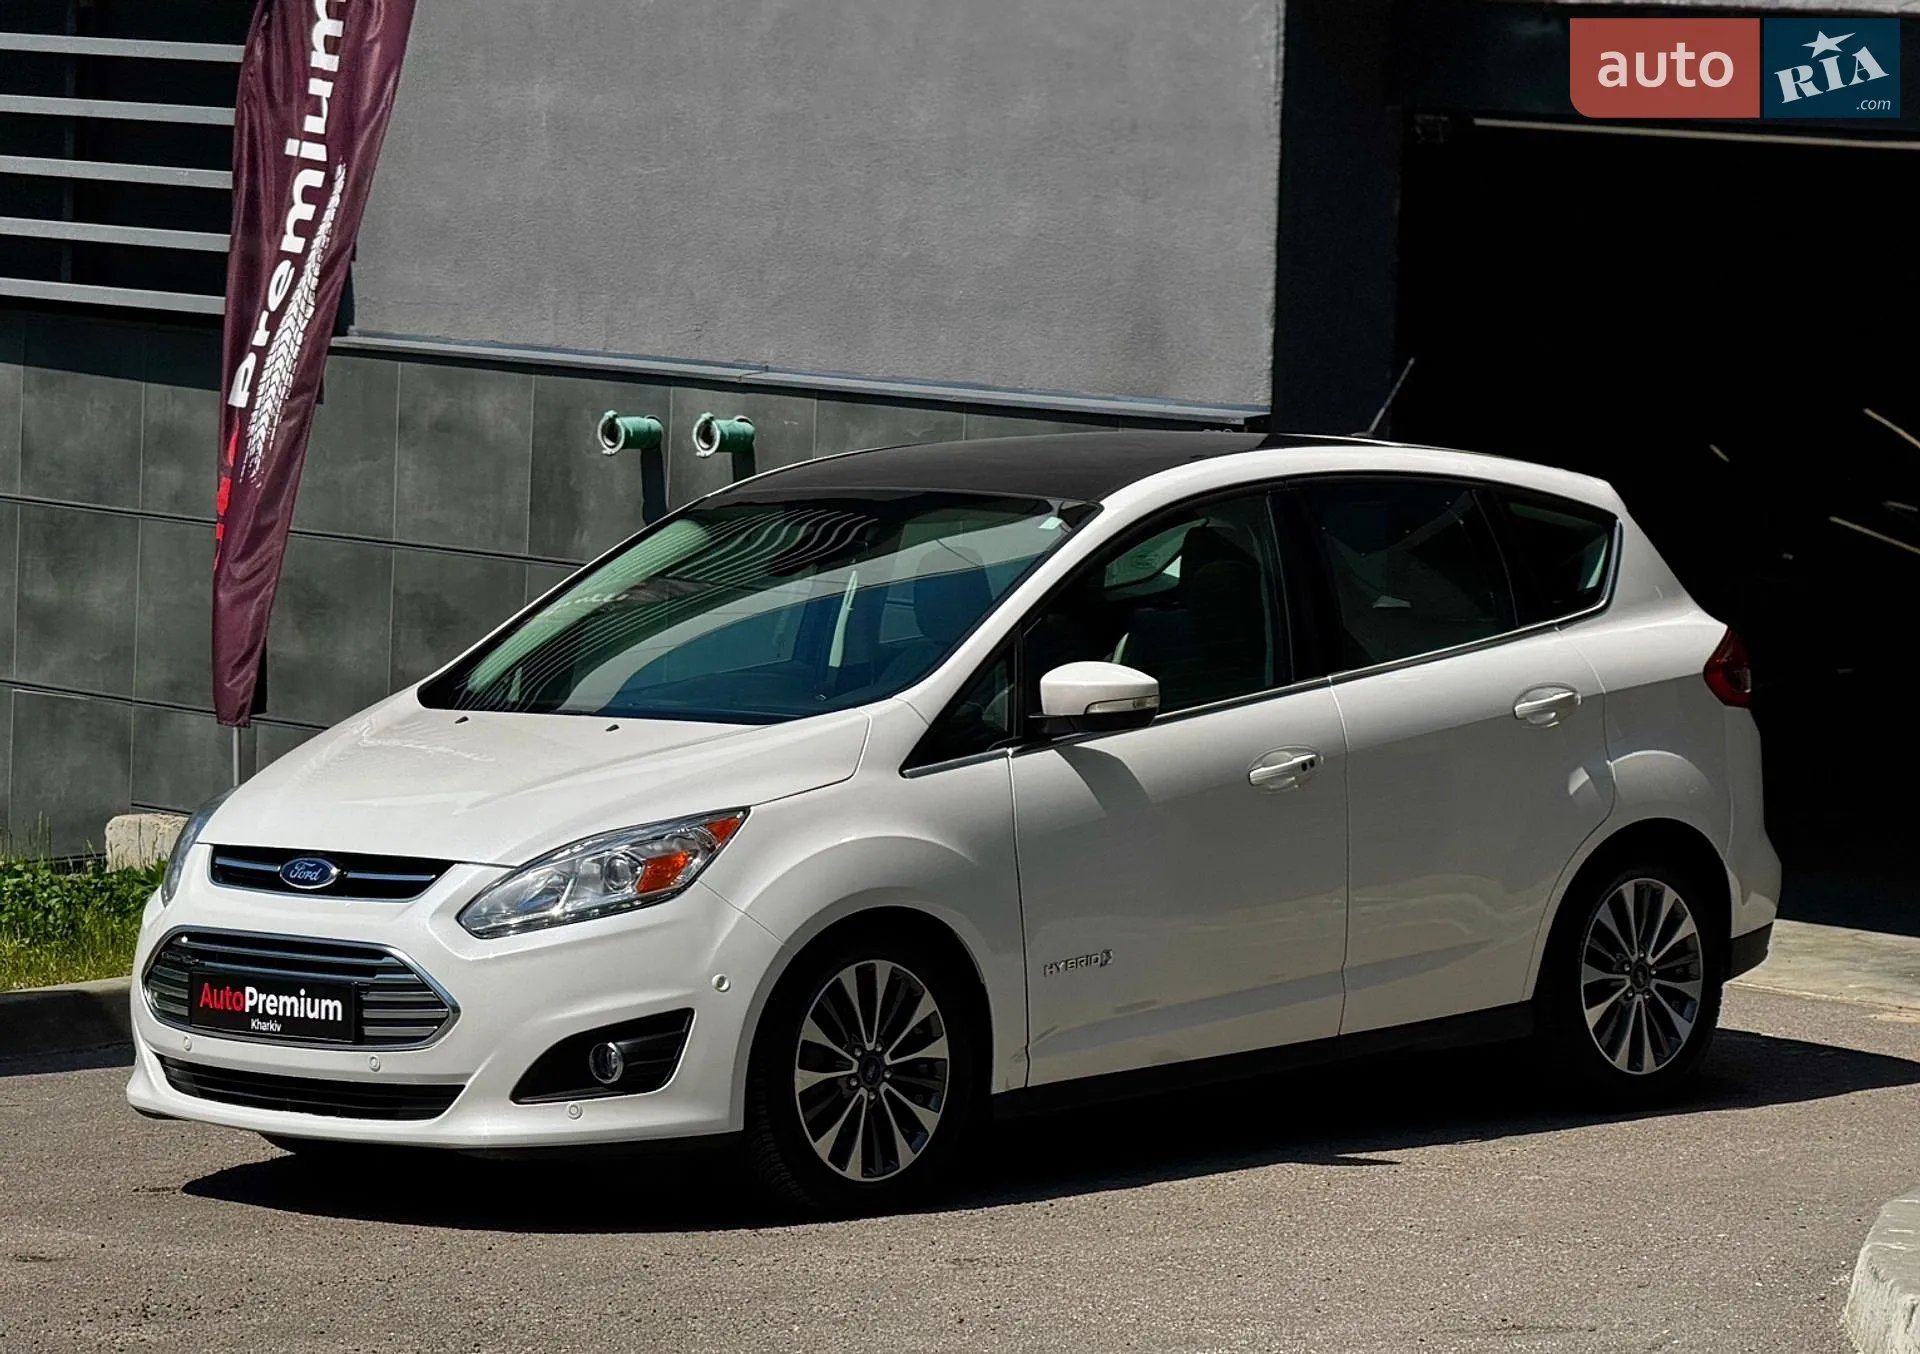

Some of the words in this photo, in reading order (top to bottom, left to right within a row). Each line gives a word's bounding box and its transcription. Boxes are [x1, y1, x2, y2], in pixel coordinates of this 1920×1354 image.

[289, 860, 323, 881] Ford
[1043, 952, 1101, 977] HYBRID
[199, 982, 343, 1022] AutoPremium
[250, 1018, 282, 1032] Kharkiv
